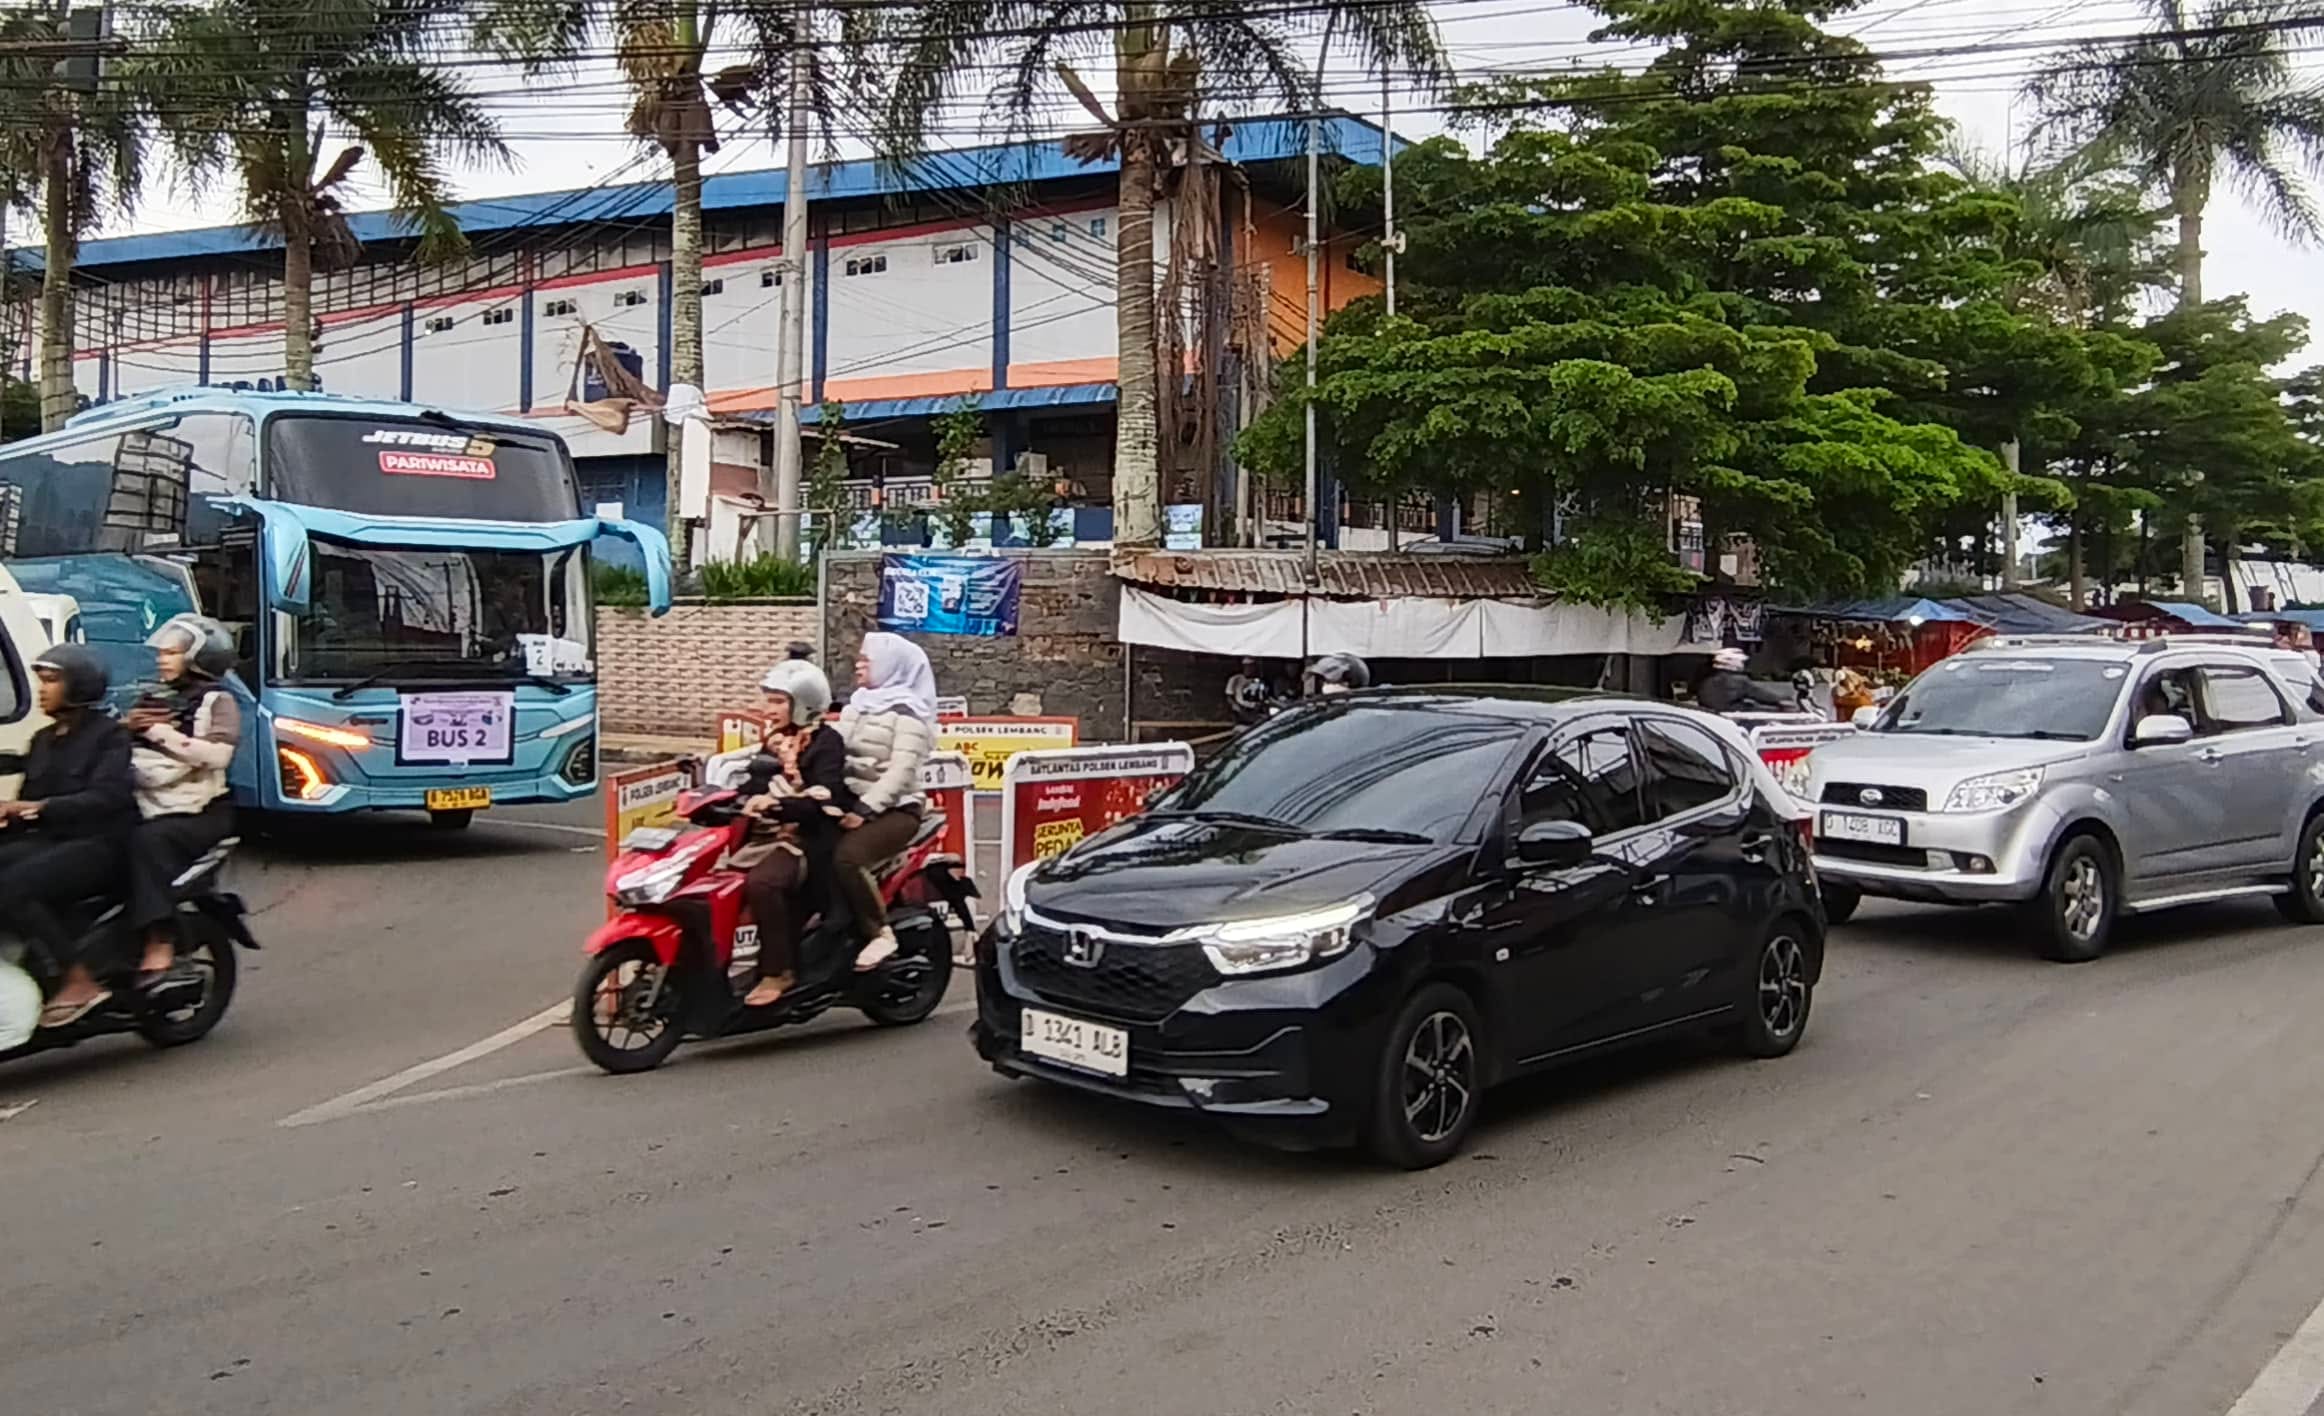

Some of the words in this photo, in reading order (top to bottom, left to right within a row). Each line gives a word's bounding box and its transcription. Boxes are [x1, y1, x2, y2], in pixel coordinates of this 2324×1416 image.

[385, 455, 489, 474] PARIWISATA
[427, 729, 468, 747] BUS
[475, 729, 487, 746] 2
[1083, 760, 1115, 772] POLSEK
